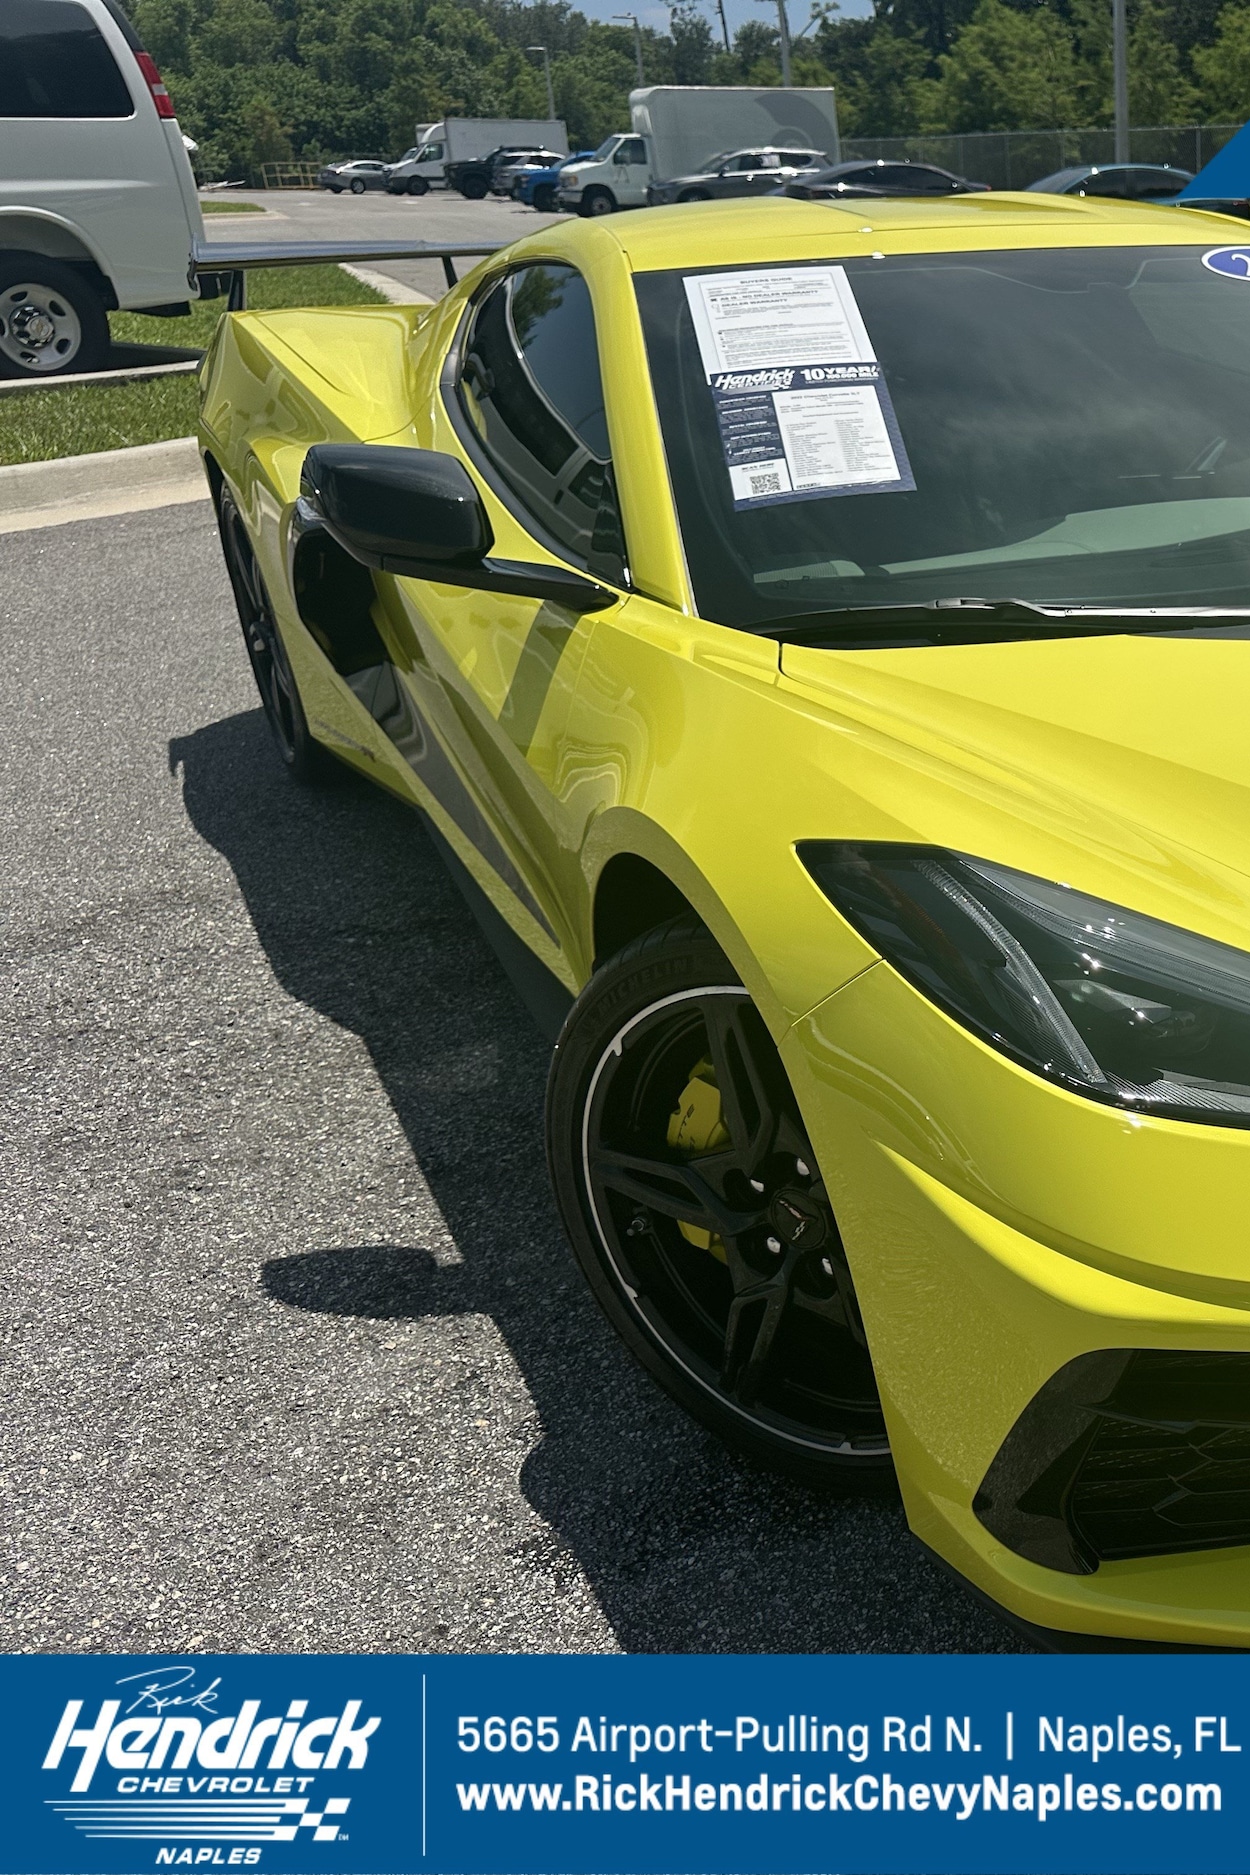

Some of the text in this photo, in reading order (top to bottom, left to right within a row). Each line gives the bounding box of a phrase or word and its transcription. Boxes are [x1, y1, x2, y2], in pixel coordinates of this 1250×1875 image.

[714, 368, 796, 391] Hendrick
[800, 367, 826, 381] 10
[598, 956, 691, 1014] MICHELIN
